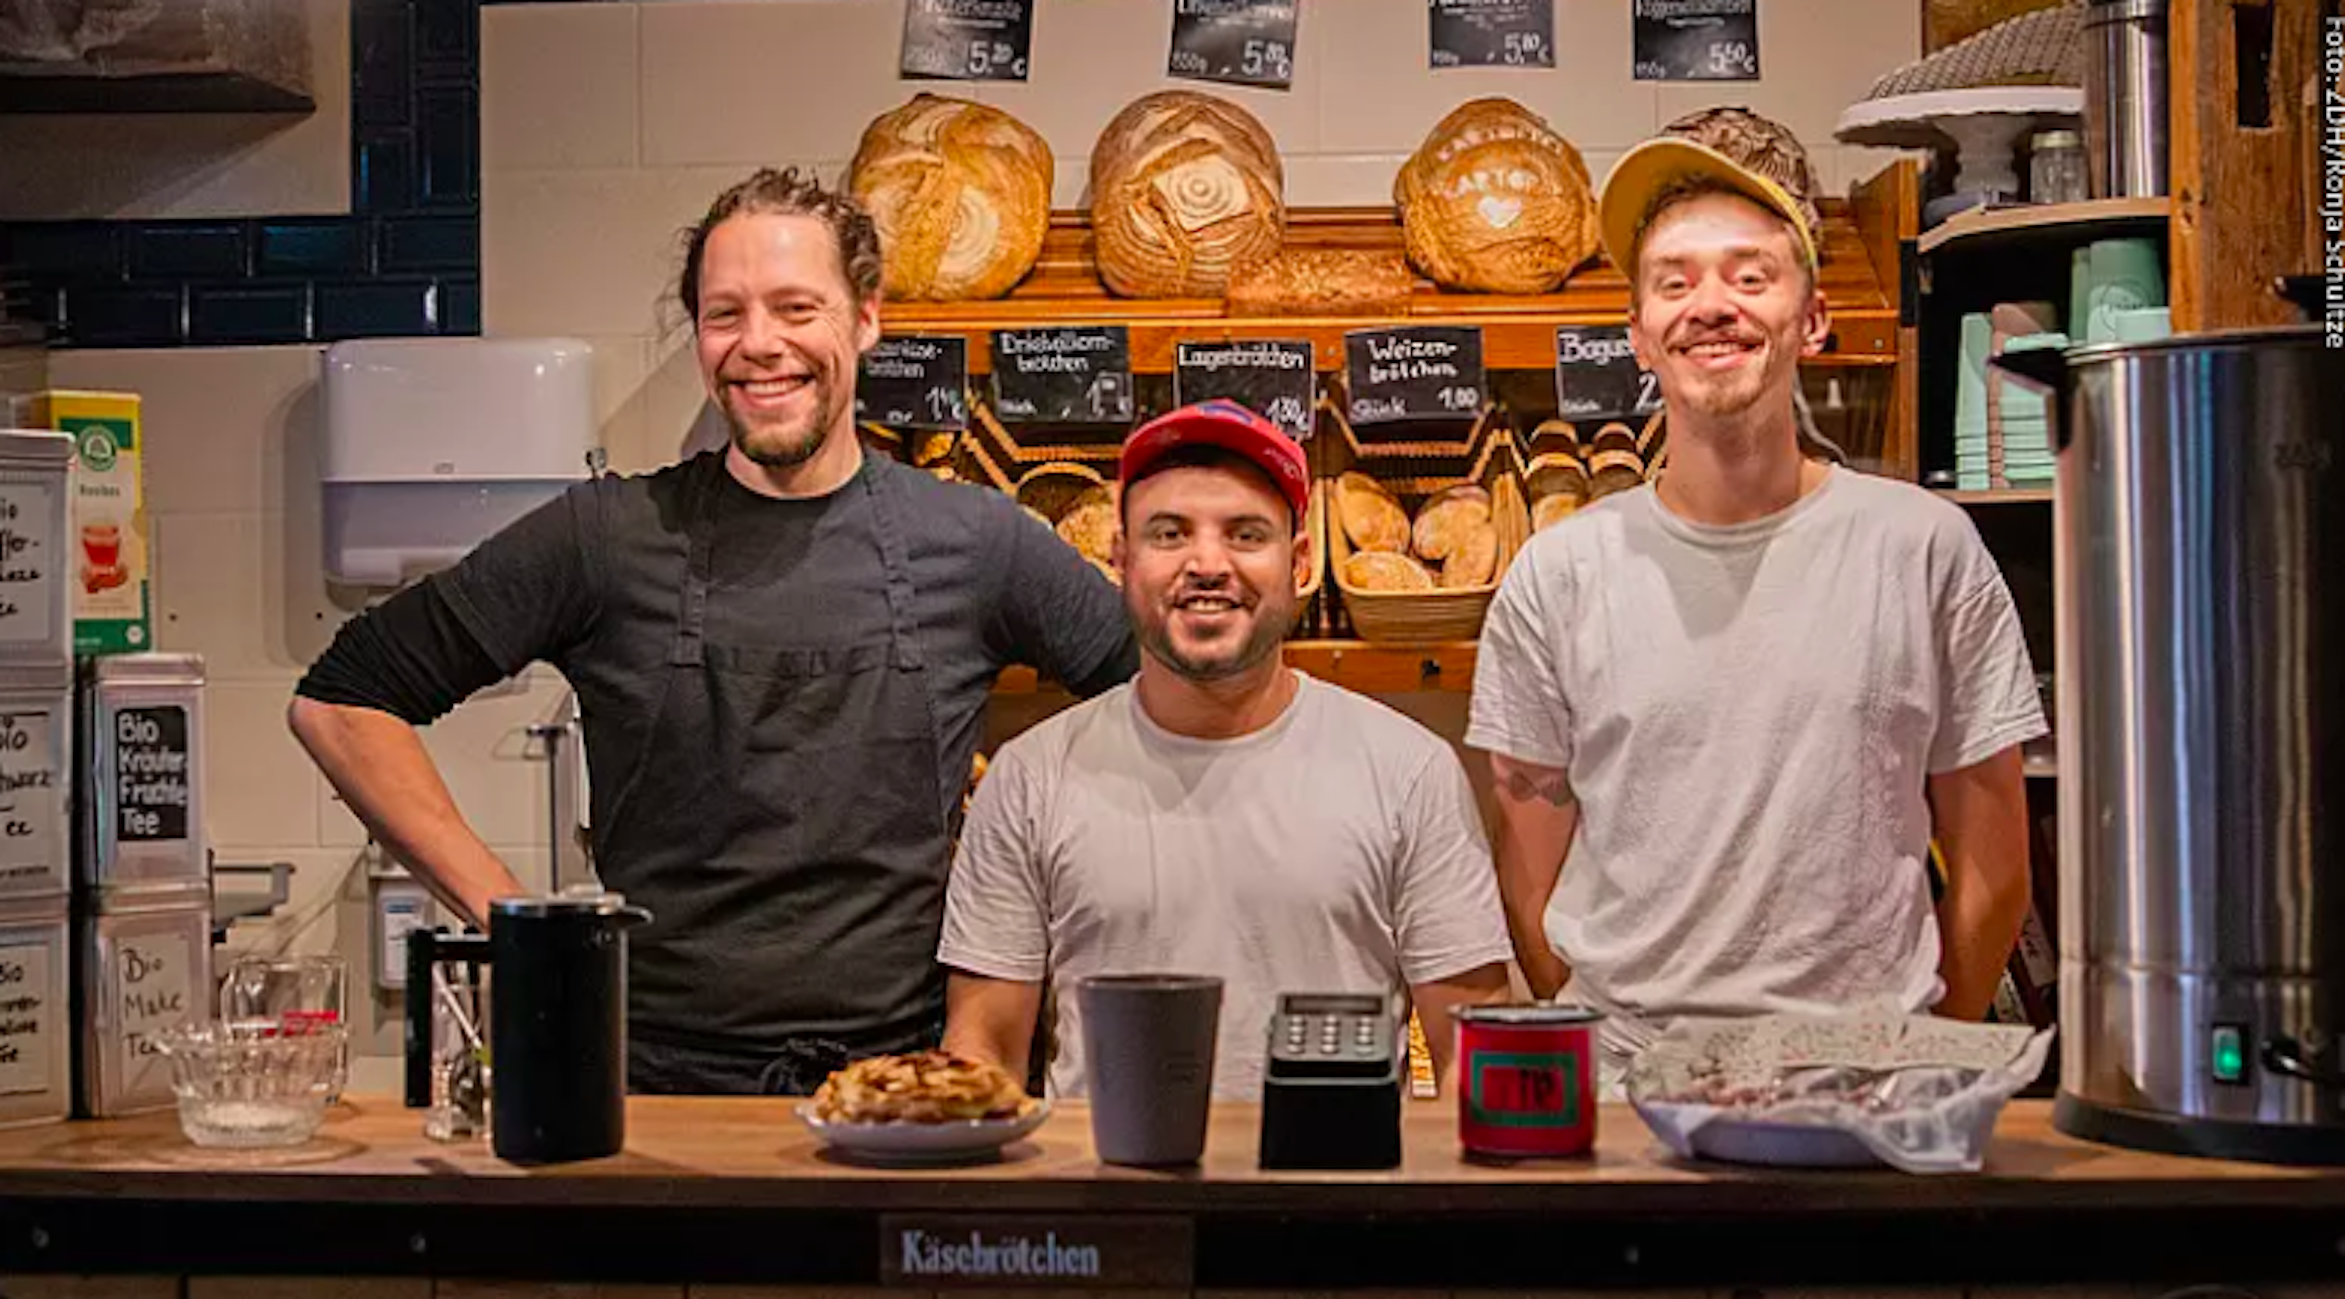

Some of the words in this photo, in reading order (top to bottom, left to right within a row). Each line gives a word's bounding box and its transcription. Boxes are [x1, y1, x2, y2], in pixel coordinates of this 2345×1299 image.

[1366, 336, 1458, 363] Weizen-
[118, 712, 161, 744] Bio
[121, 807, 160, 836] Tee
[121, 948, 163, 983] Bio
[901, 1229, 1100, 1276] Käsebrötchen
